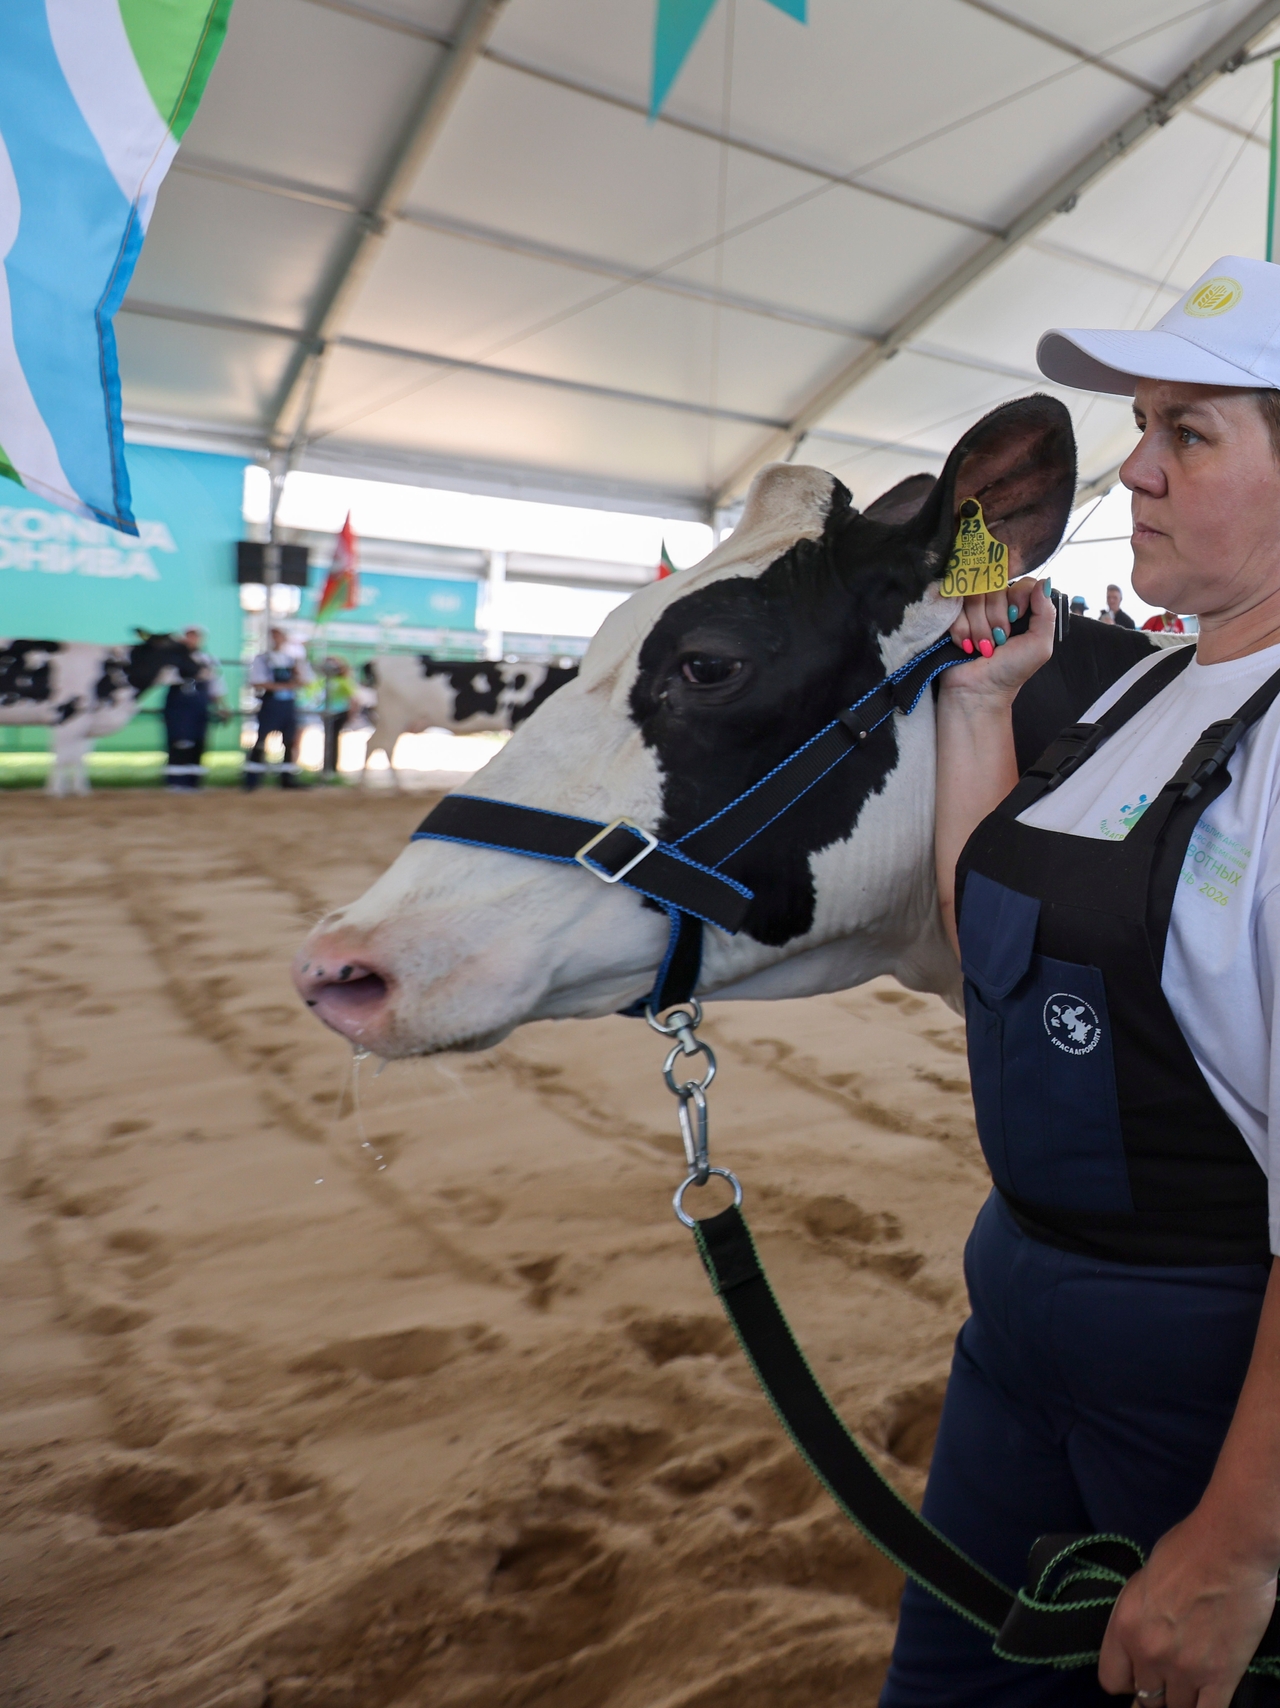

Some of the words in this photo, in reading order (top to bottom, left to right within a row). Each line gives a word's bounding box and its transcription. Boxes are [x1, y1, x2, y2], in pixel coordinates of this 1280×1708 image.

[962, 519, 981, 535] 23
[961, 558, 971, 566] RU
[987, 541, 1005, 564] 10
[942, 564, 1005, 595] 06713
[1193, 830, 1207, 845] УРС
[1186, 843, 1243, 887] ВОТНЫХ
[1180, 868, 1195, 886] НЬ
[1199, 882, 1229, 907] 2026
[1051, 1037, 1074, 1055] КРАСА
[1074, 1028, 1102, 1055] АГРОВОЛГИ
